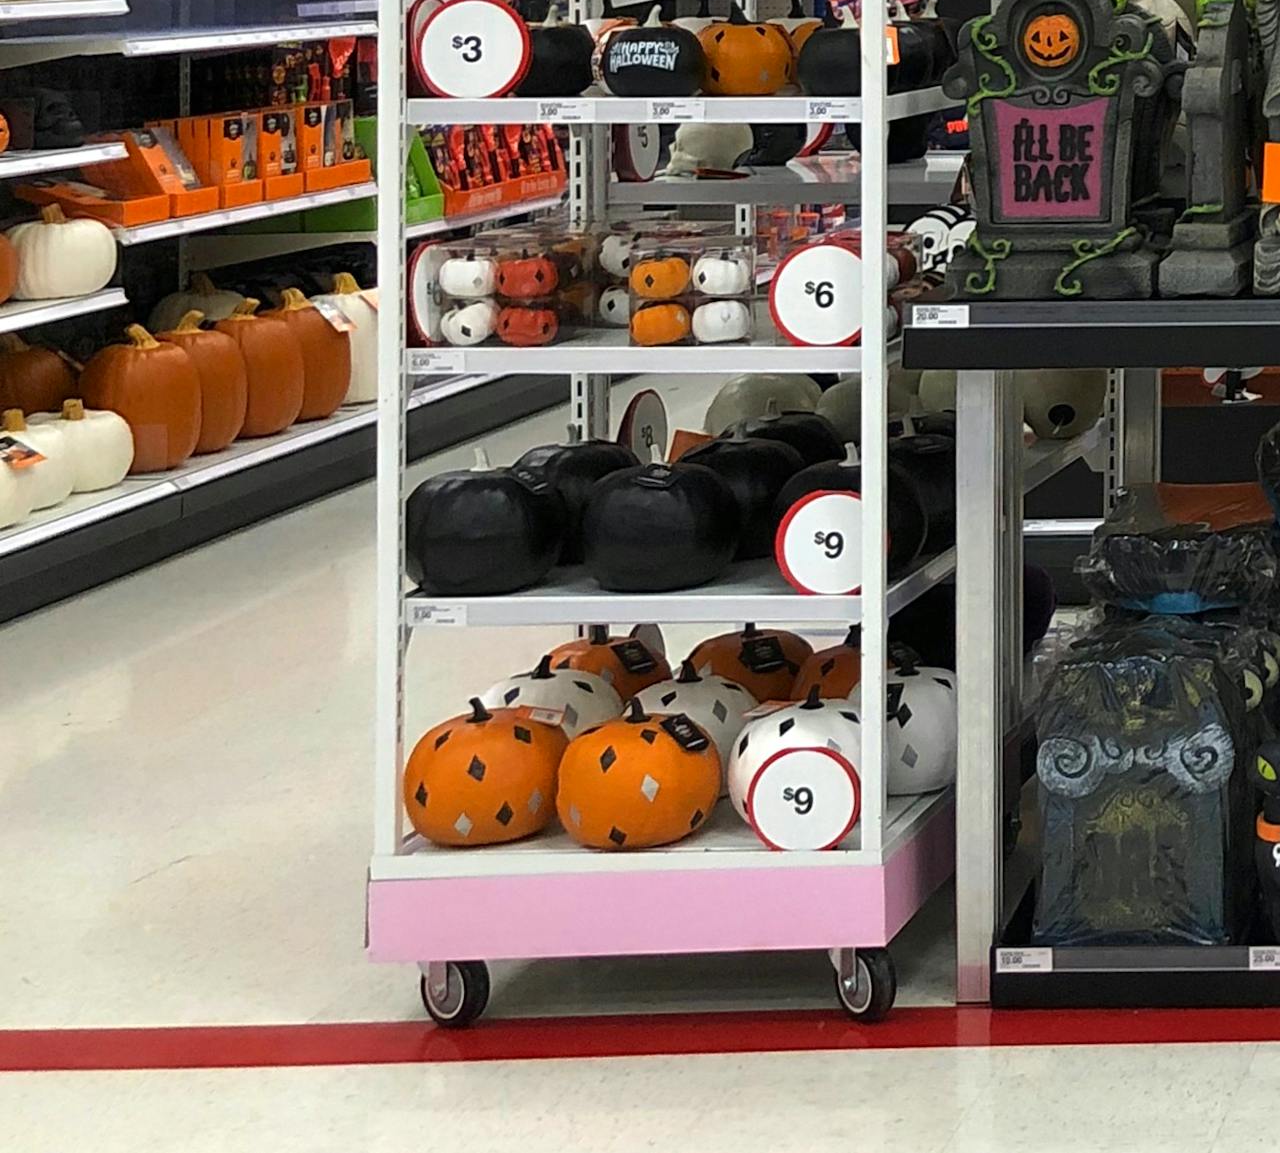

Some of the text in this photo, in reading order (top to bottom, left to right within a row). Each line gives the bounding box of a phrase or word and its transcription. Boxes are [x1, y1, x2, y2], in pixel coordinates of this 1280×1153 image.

[452, 35, 483, 63] $3
[622, 41, 662, 54] HAPPY
[609, 52, 676, 73] HALLOWEEN
[1013, 118, 1095, 162] I'LL BE
[1014, 163, 1091, 202] BACK
[804, 281, 835, 309] $6
[916, 312, 938, 320] 20.00
[641, 424, 653, 448] $8
[814, 530, 844, 560] $9
[783, 786, 813, 815] $9
